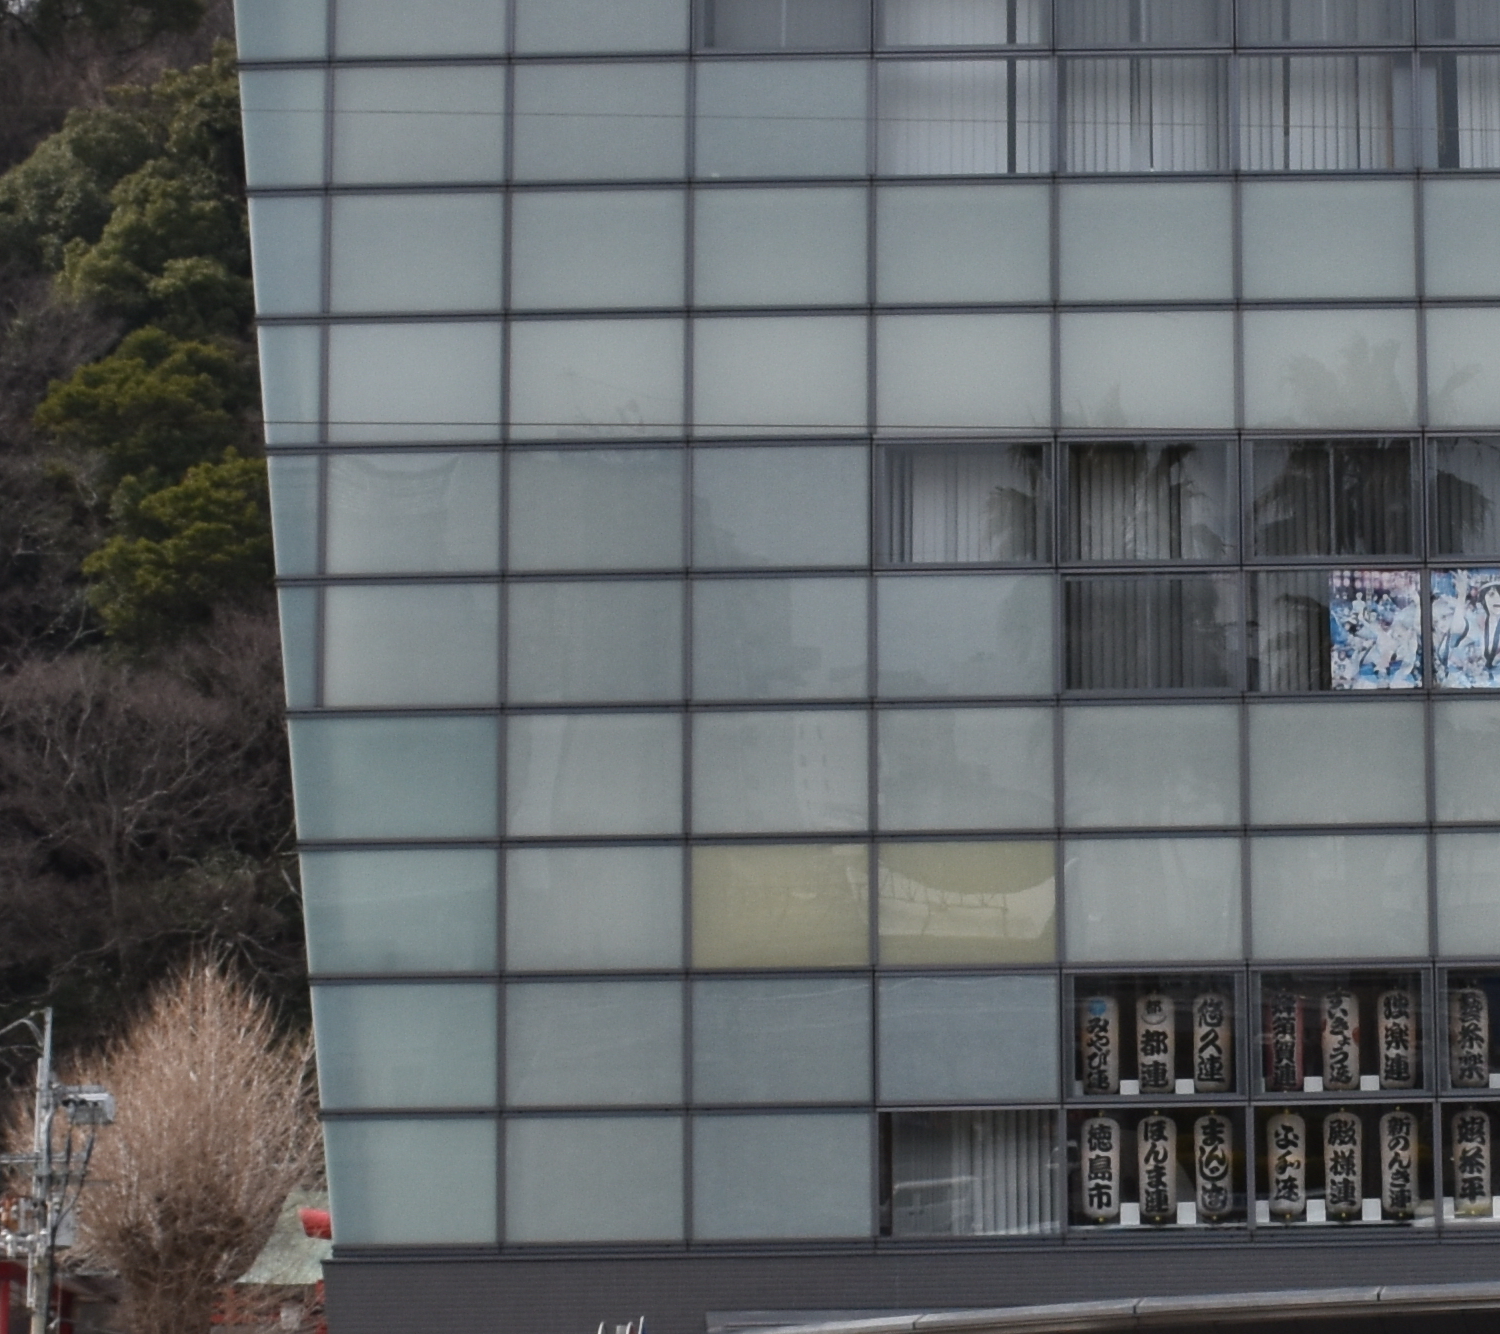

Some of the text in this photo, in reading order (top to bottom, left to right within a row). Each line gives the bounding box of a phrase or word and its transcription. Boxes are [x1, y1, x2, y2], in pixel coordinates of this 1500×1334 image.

[1140, 1029, 1169, 1088] 都連
[1088, 1124, 1113, 1209] 徳島市
[1143, 1120, 1169, 1213] ほんま連
